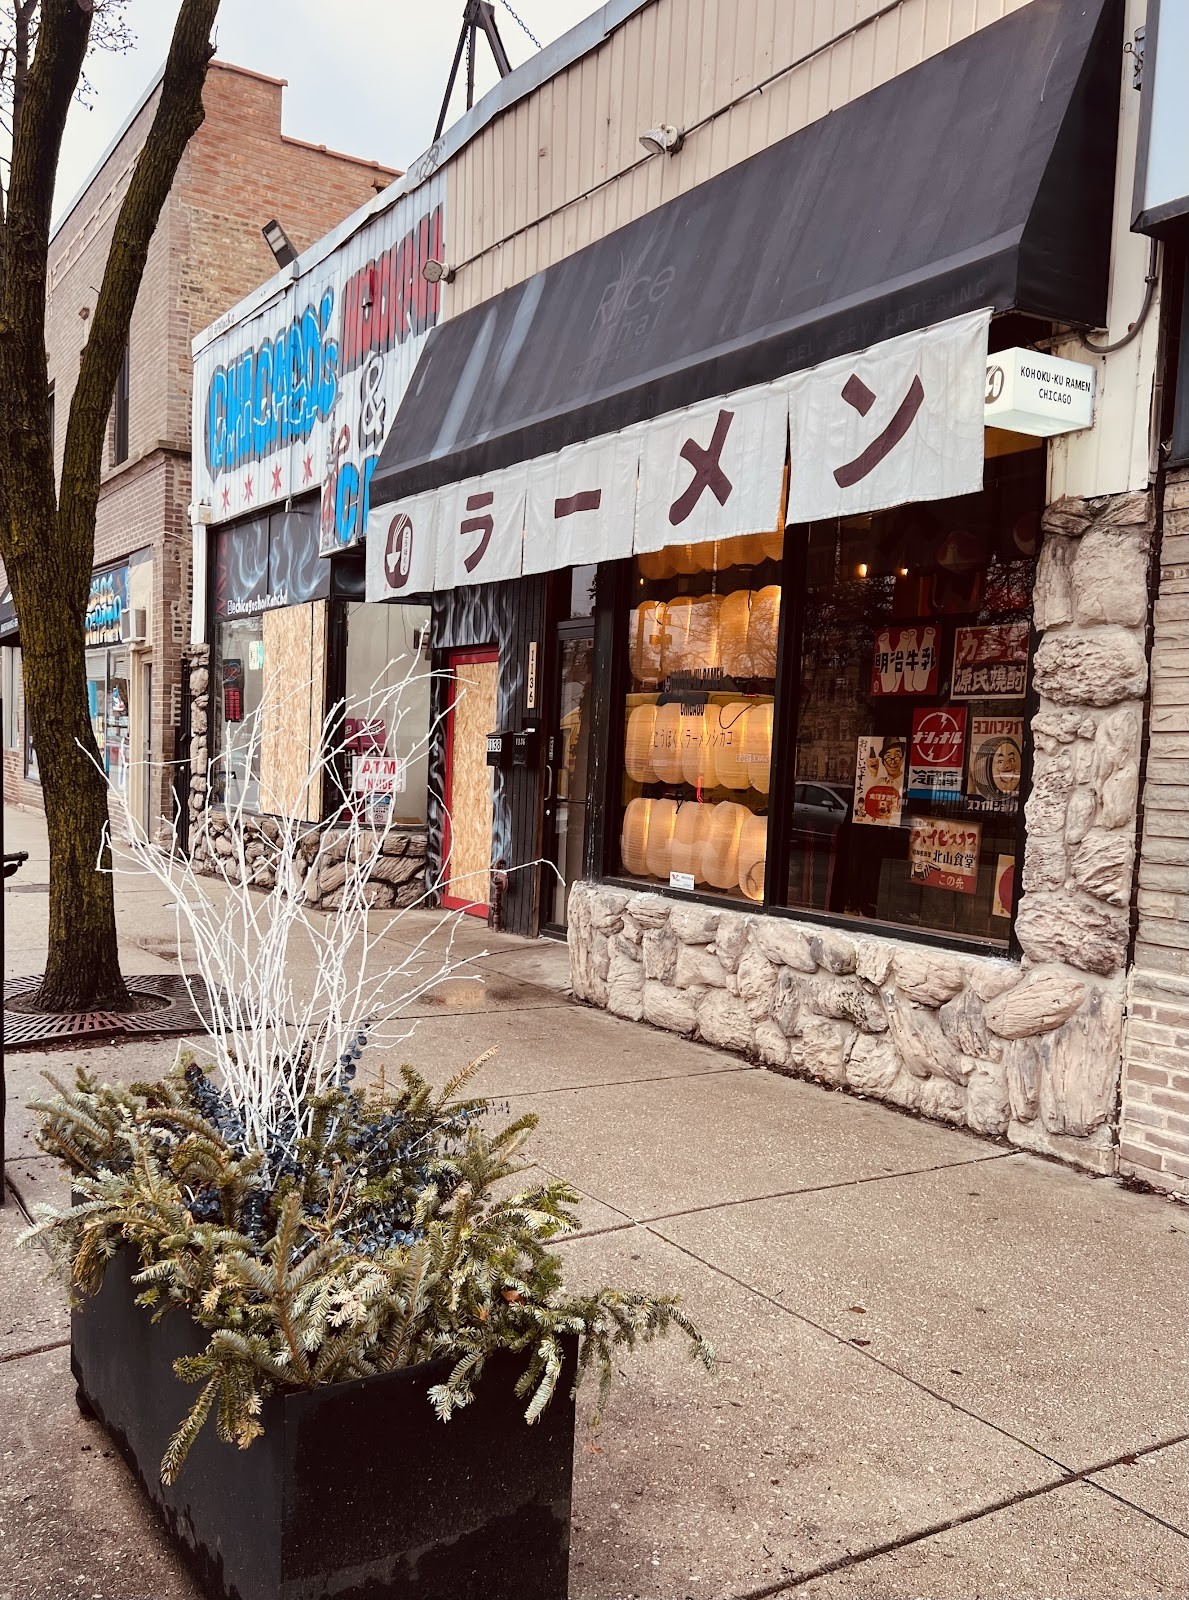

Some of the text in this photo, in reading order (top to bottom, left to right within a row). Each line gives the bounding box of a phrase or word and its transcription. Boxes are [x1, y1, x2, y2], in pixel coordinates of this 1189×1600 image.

[1065, 377, 1090, 392] RAMEN
[1038, 388, 1072, 404] CHICAGO
[875, 647, 936, 673] 明治牛乳
[973, 721, 1024, 734] ヨコハマタイ
[913, 732, 962, 743] ナショナル
[362, 761, 395, 774] ATM
[365, 778, 393, 790] NIDE
[933, 850, 975, 868] 北山食堂
[939, 873, 964, 890] この先
